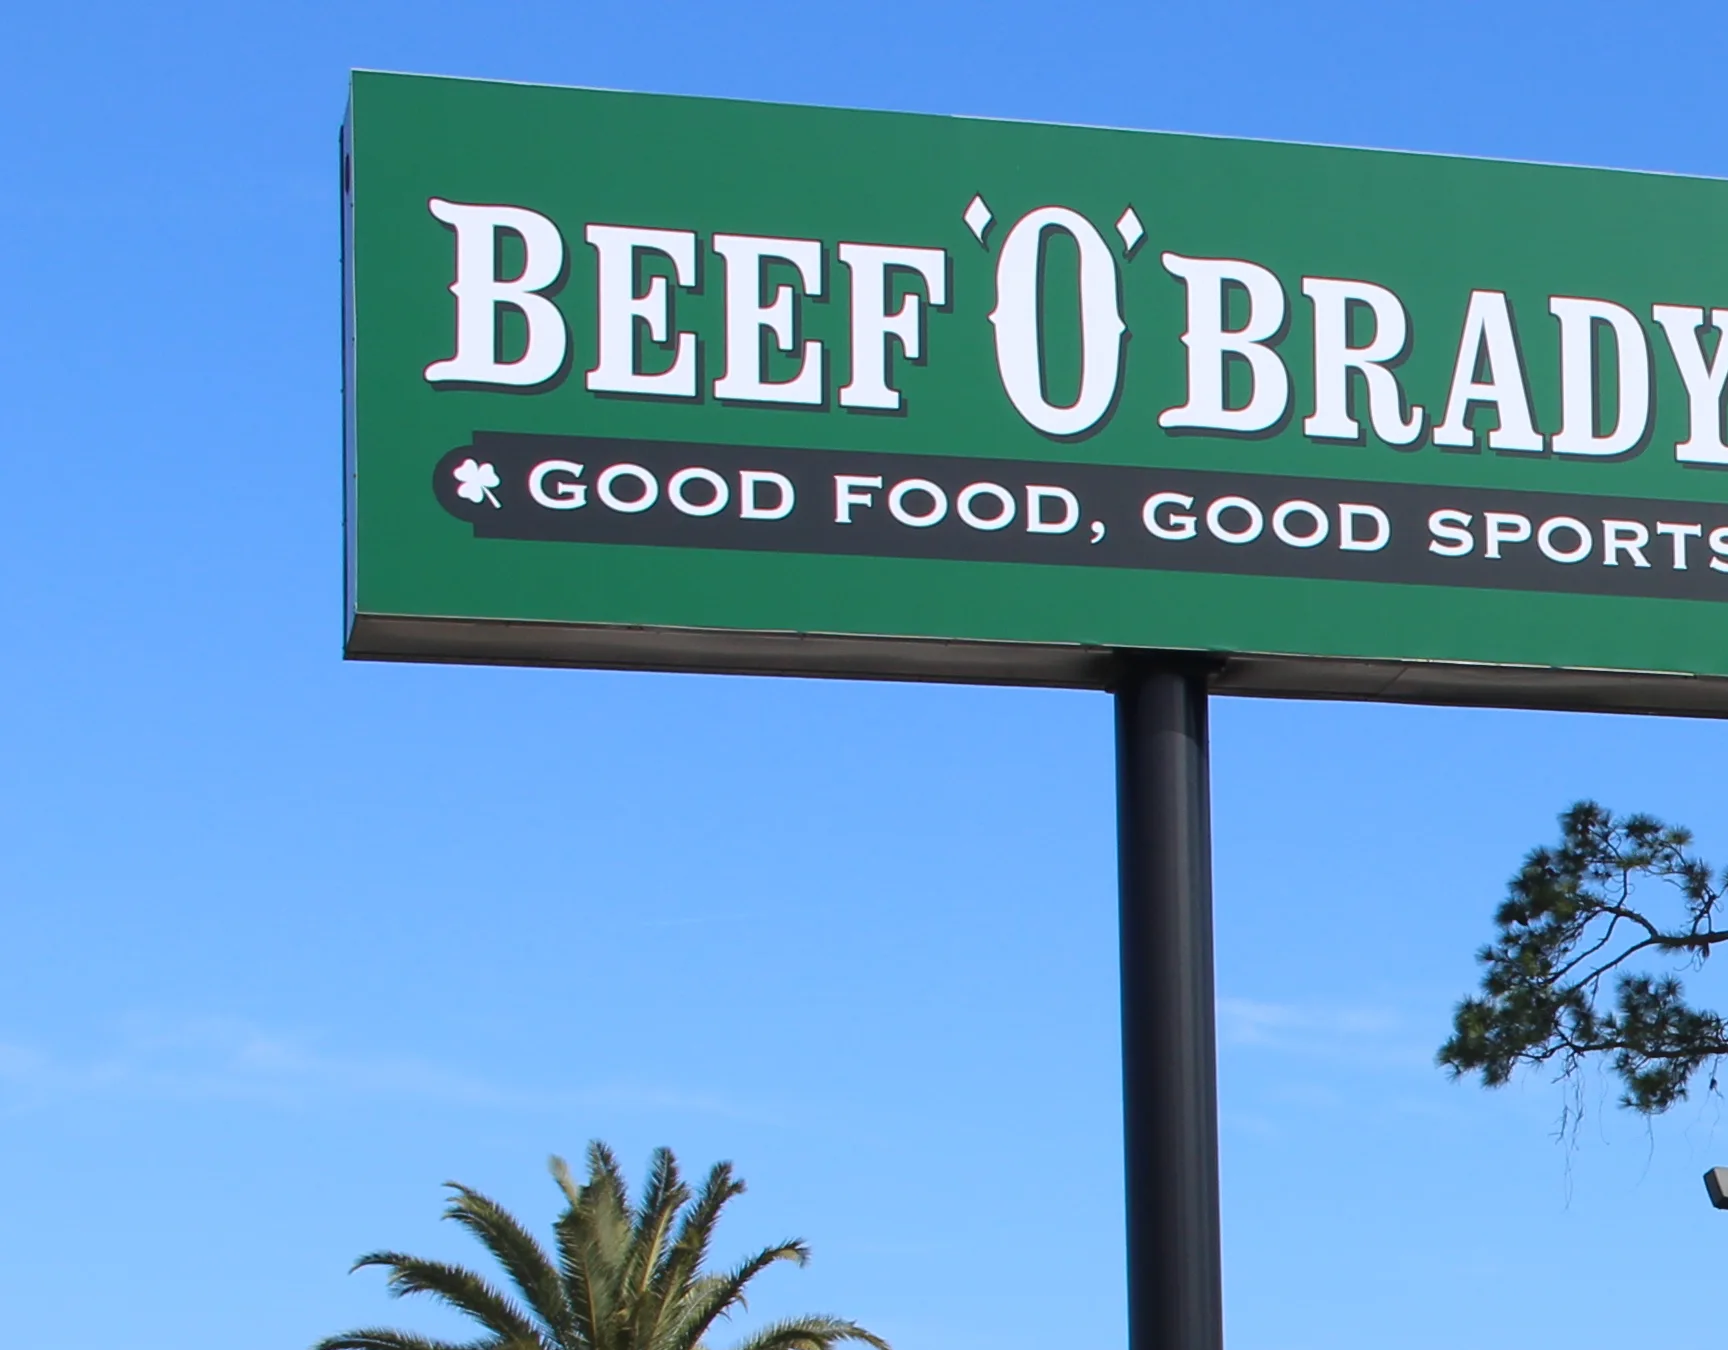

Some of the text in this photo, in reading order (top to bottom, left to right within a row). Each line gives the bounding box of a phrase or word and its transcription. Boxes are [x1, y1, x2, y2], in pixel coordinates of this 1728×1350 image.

[423, 197, 946, 409] BEEF
[528, 459, 795, 519] GOOD
[834, 475, 1105, 543] FOOD,
[1143, 492, 1390, 551] GOOD
